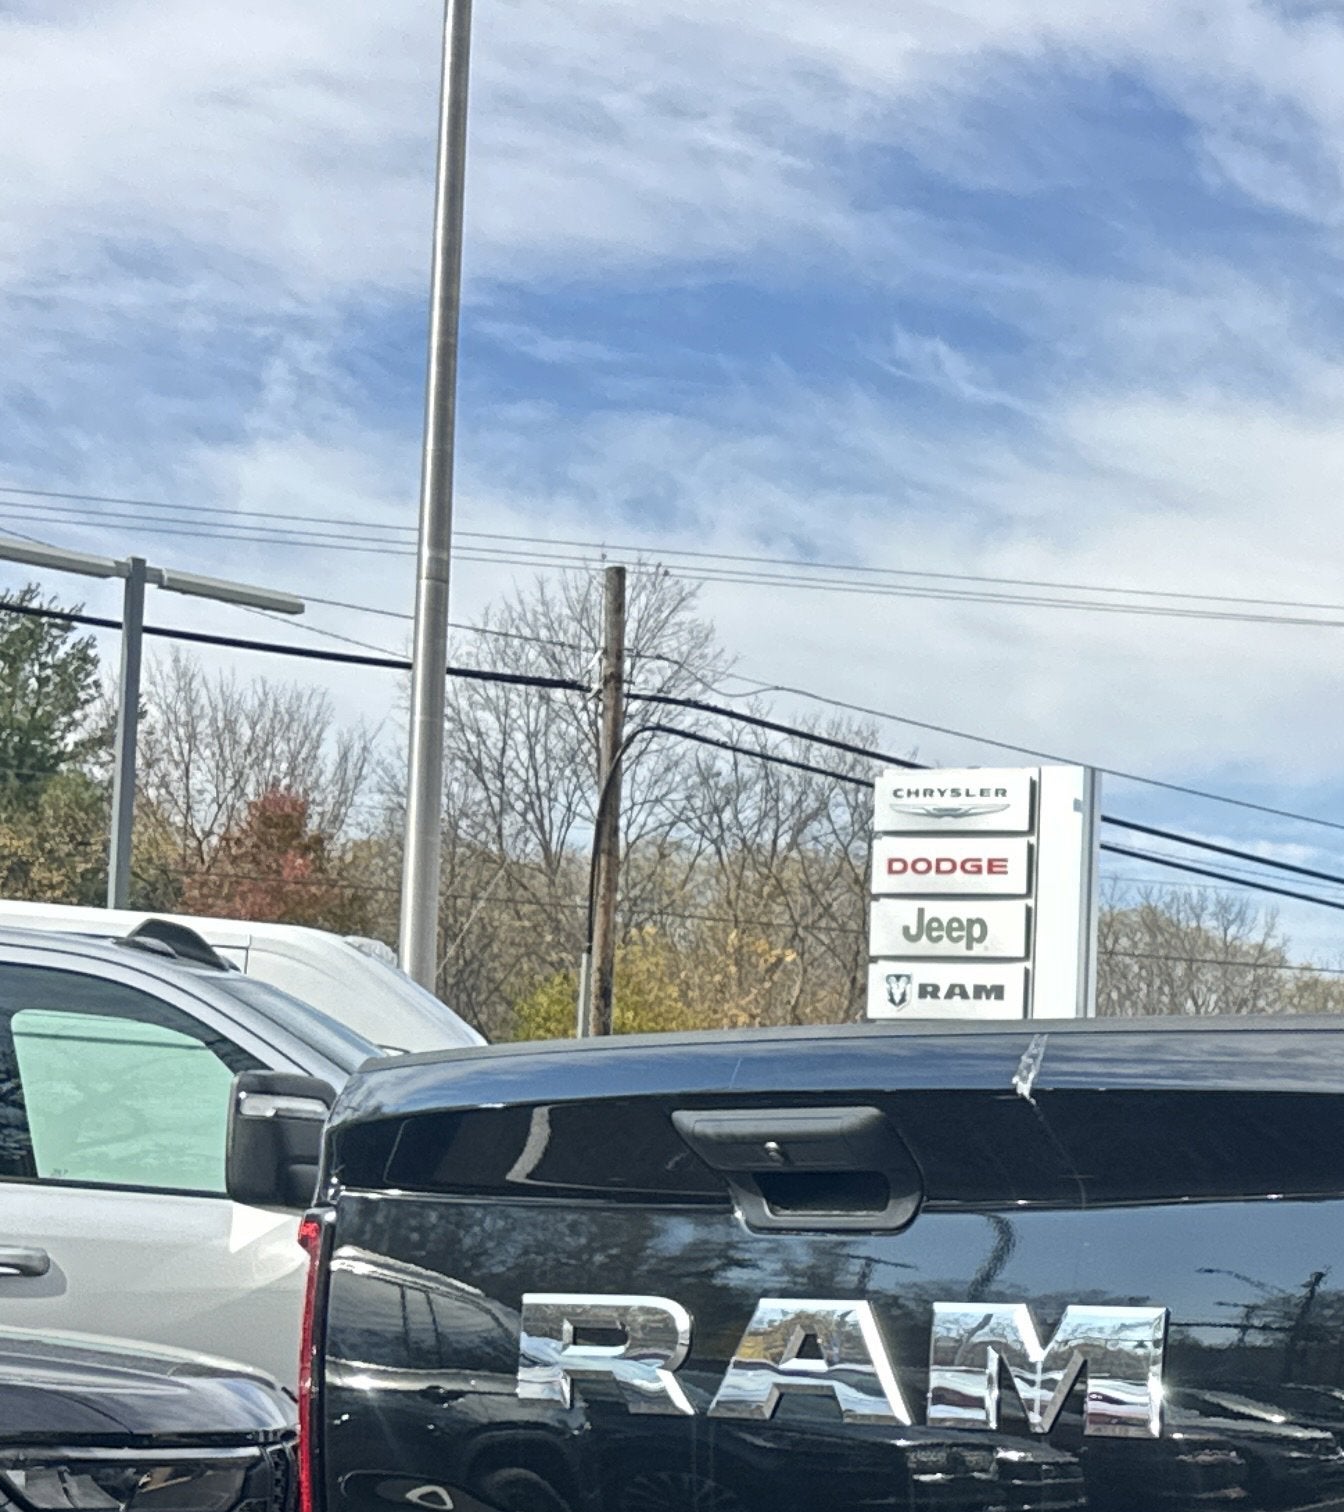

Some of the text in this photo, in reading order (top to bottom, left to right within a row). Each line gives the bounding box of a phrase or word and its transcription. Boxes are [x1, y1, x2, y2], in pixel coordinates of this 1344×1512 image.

[892, 787, 1008, 799] CHRYSLER
[887, 857, 1009, 875] DODGE
[902, 907, 988, 951] Jeep
[918, 983, 1005, 1001] RAM
[517, 1293, 1169, 1439] RAM
